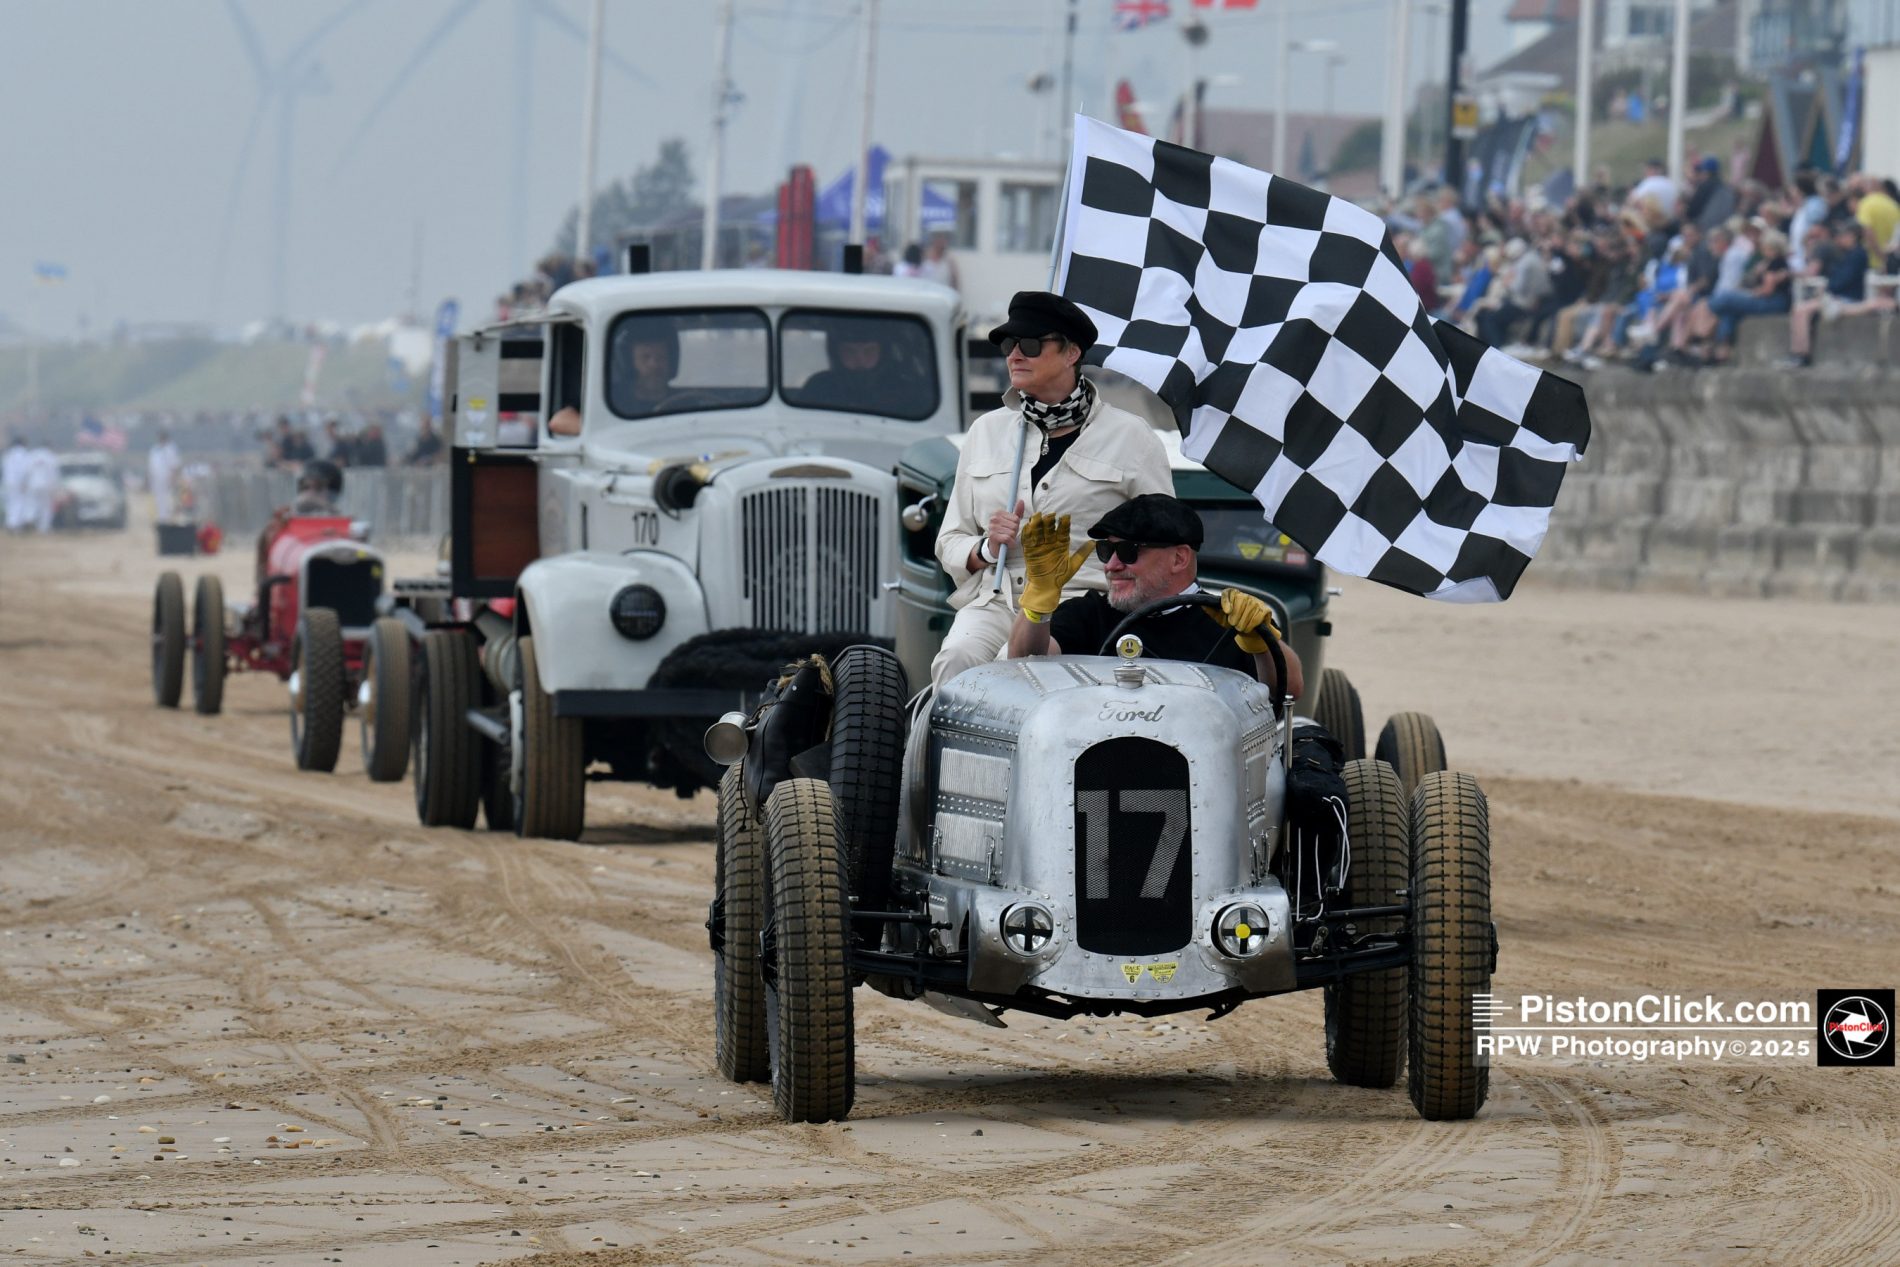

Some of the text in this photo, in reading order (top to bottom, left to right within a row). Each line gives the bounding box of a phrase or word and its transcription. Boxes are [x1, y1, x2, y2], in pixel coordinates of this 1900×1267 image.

[632, 511, 660, 546] 170
[1098, 700, 1166, 723] Ford
[1077, 789, 1189, 899] 17
